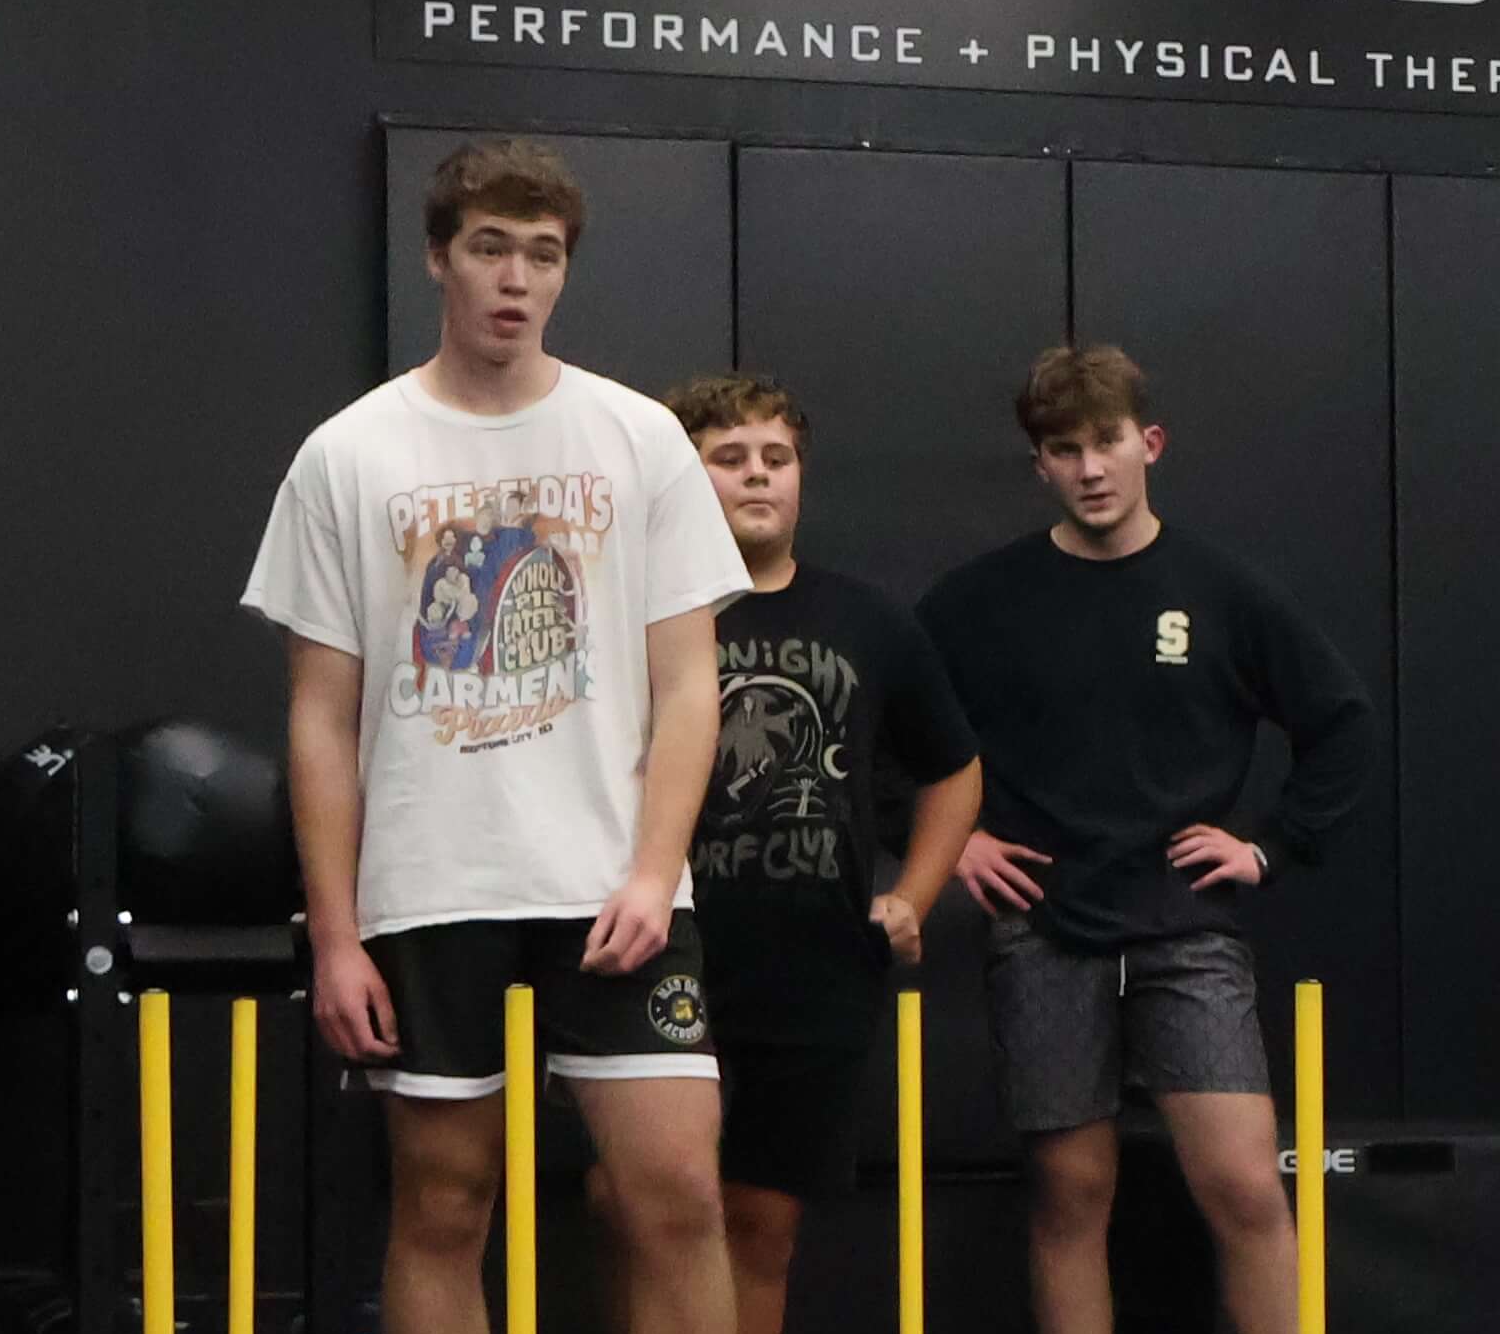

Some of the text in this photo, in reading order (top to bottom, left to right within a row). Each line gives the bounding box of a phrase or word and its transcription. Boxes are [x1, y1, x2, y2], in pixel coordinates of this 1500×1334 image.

[424, 1, 923, 65] PERFORMANCE
[1026, 34, 1335, 85] PHYSICAL
[1157, 610, 1190, 656] S
